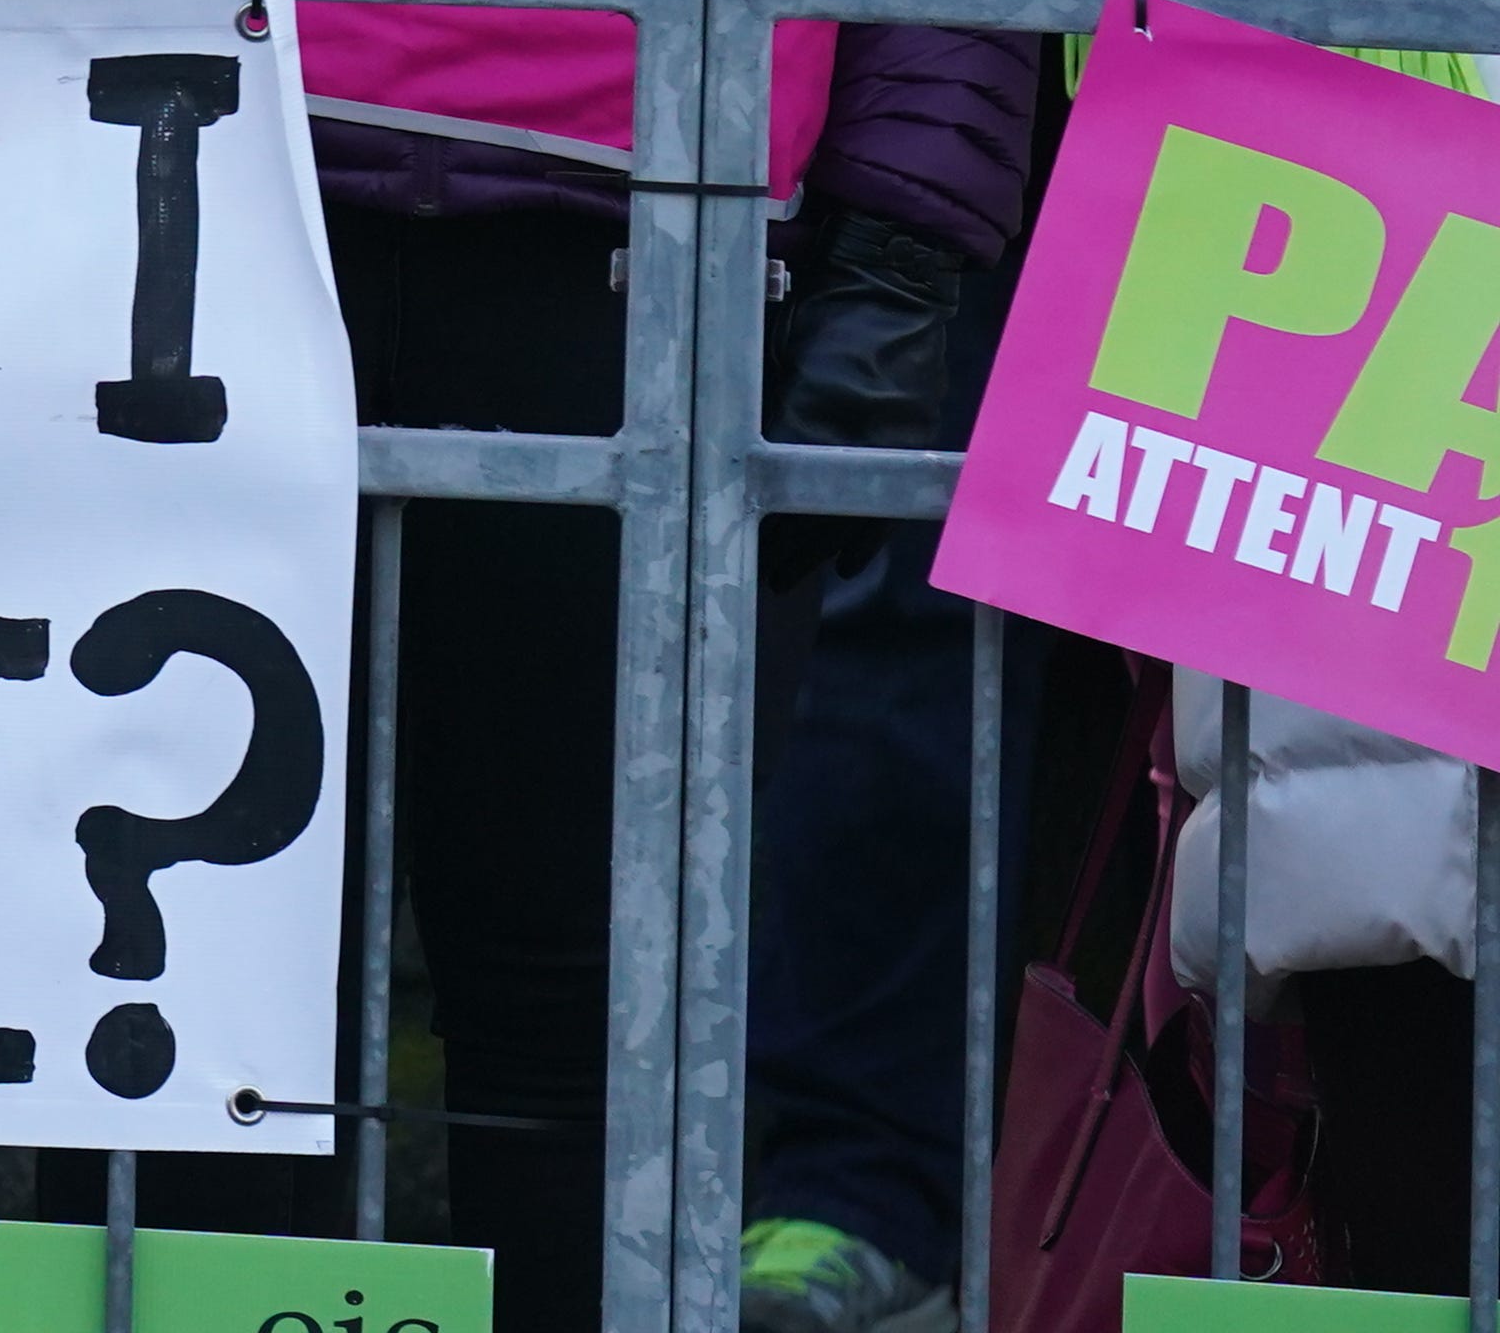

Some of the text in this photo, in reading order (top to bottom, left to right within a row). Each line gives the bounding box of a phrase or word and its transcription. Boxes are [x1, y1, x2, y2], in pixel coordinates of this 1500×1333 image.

[87, 51, 242, 446] I
[1088, 123, 1500, 493] PA
[1048, 409, 1500, 673] ATTENT1
